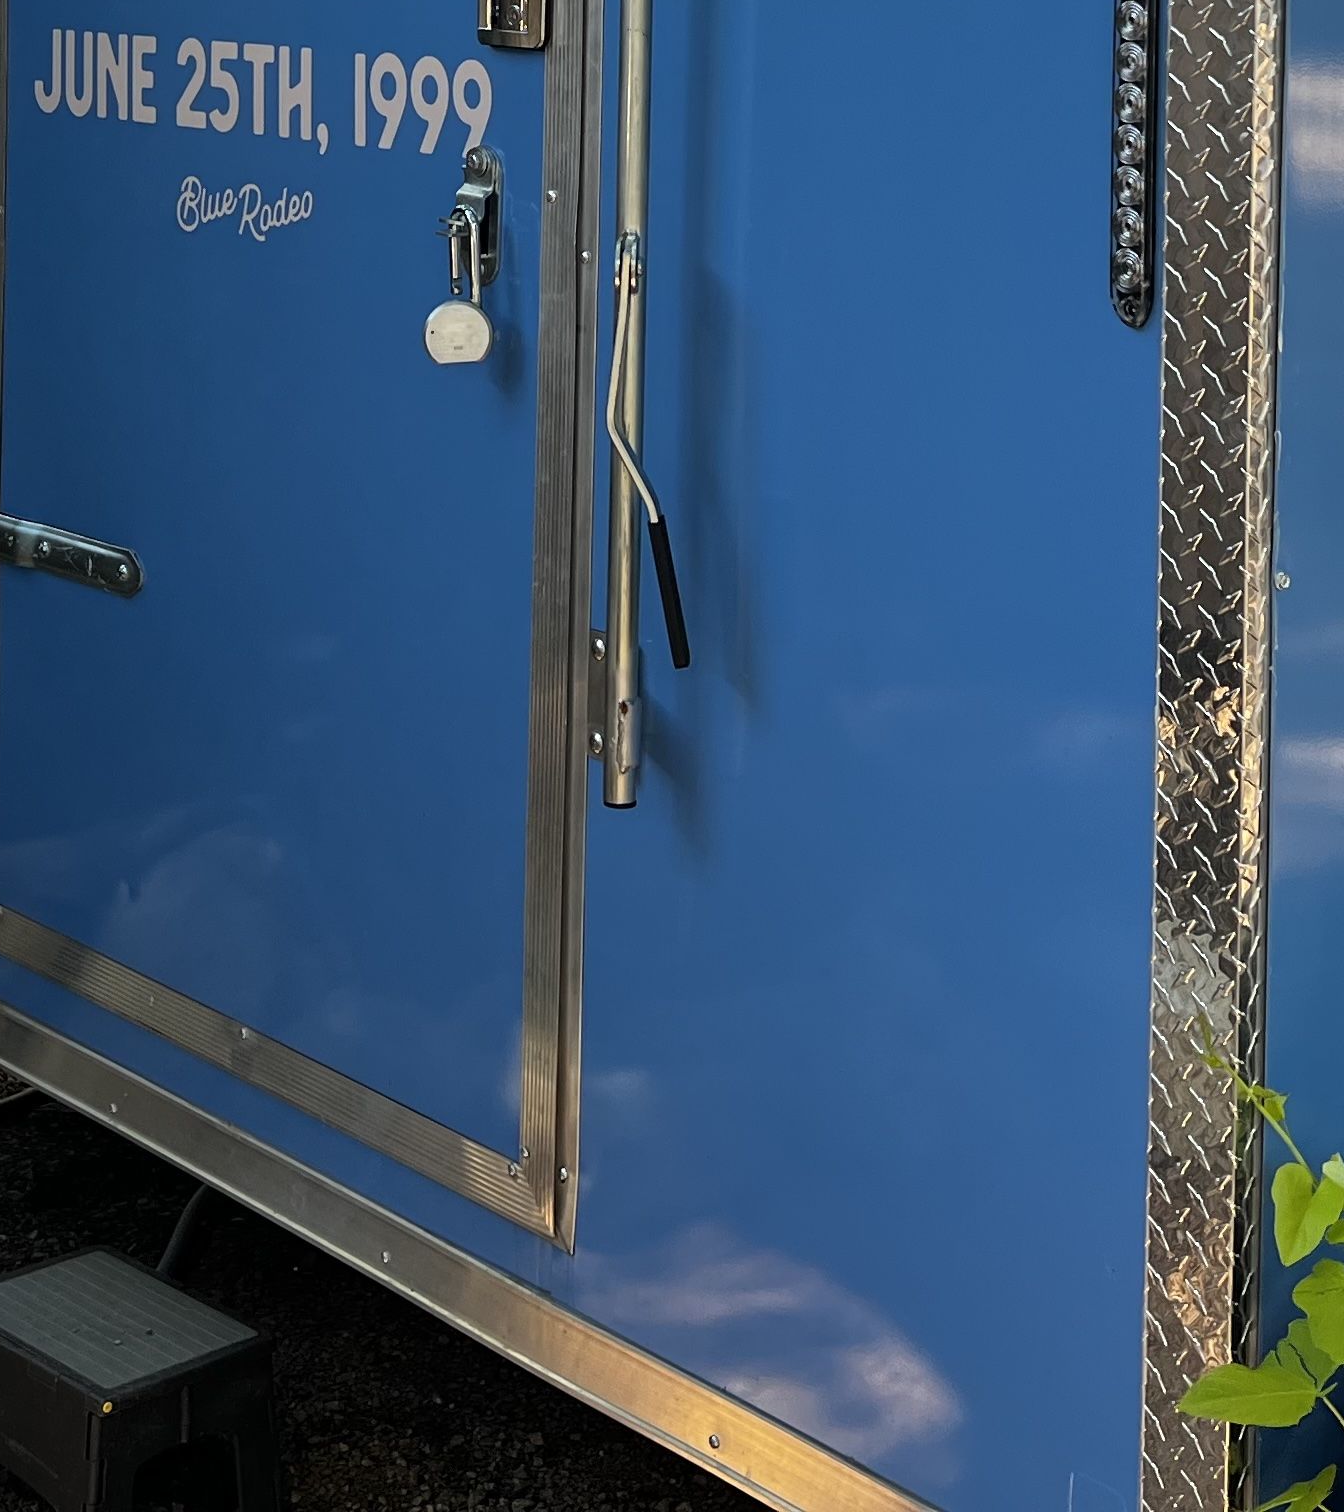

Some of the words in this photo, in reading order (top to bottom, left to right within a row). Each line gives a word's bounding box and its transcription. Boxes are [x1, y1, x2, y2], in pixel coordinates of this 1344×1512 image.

[34, 28, 158, 125] JUNE
[175, 36, 330, 156] 25TH,
[353, 52, 494, 159] 1999
[176, 174, 238, 234] Blue
[238, 182, 314, 242] Rodeo
